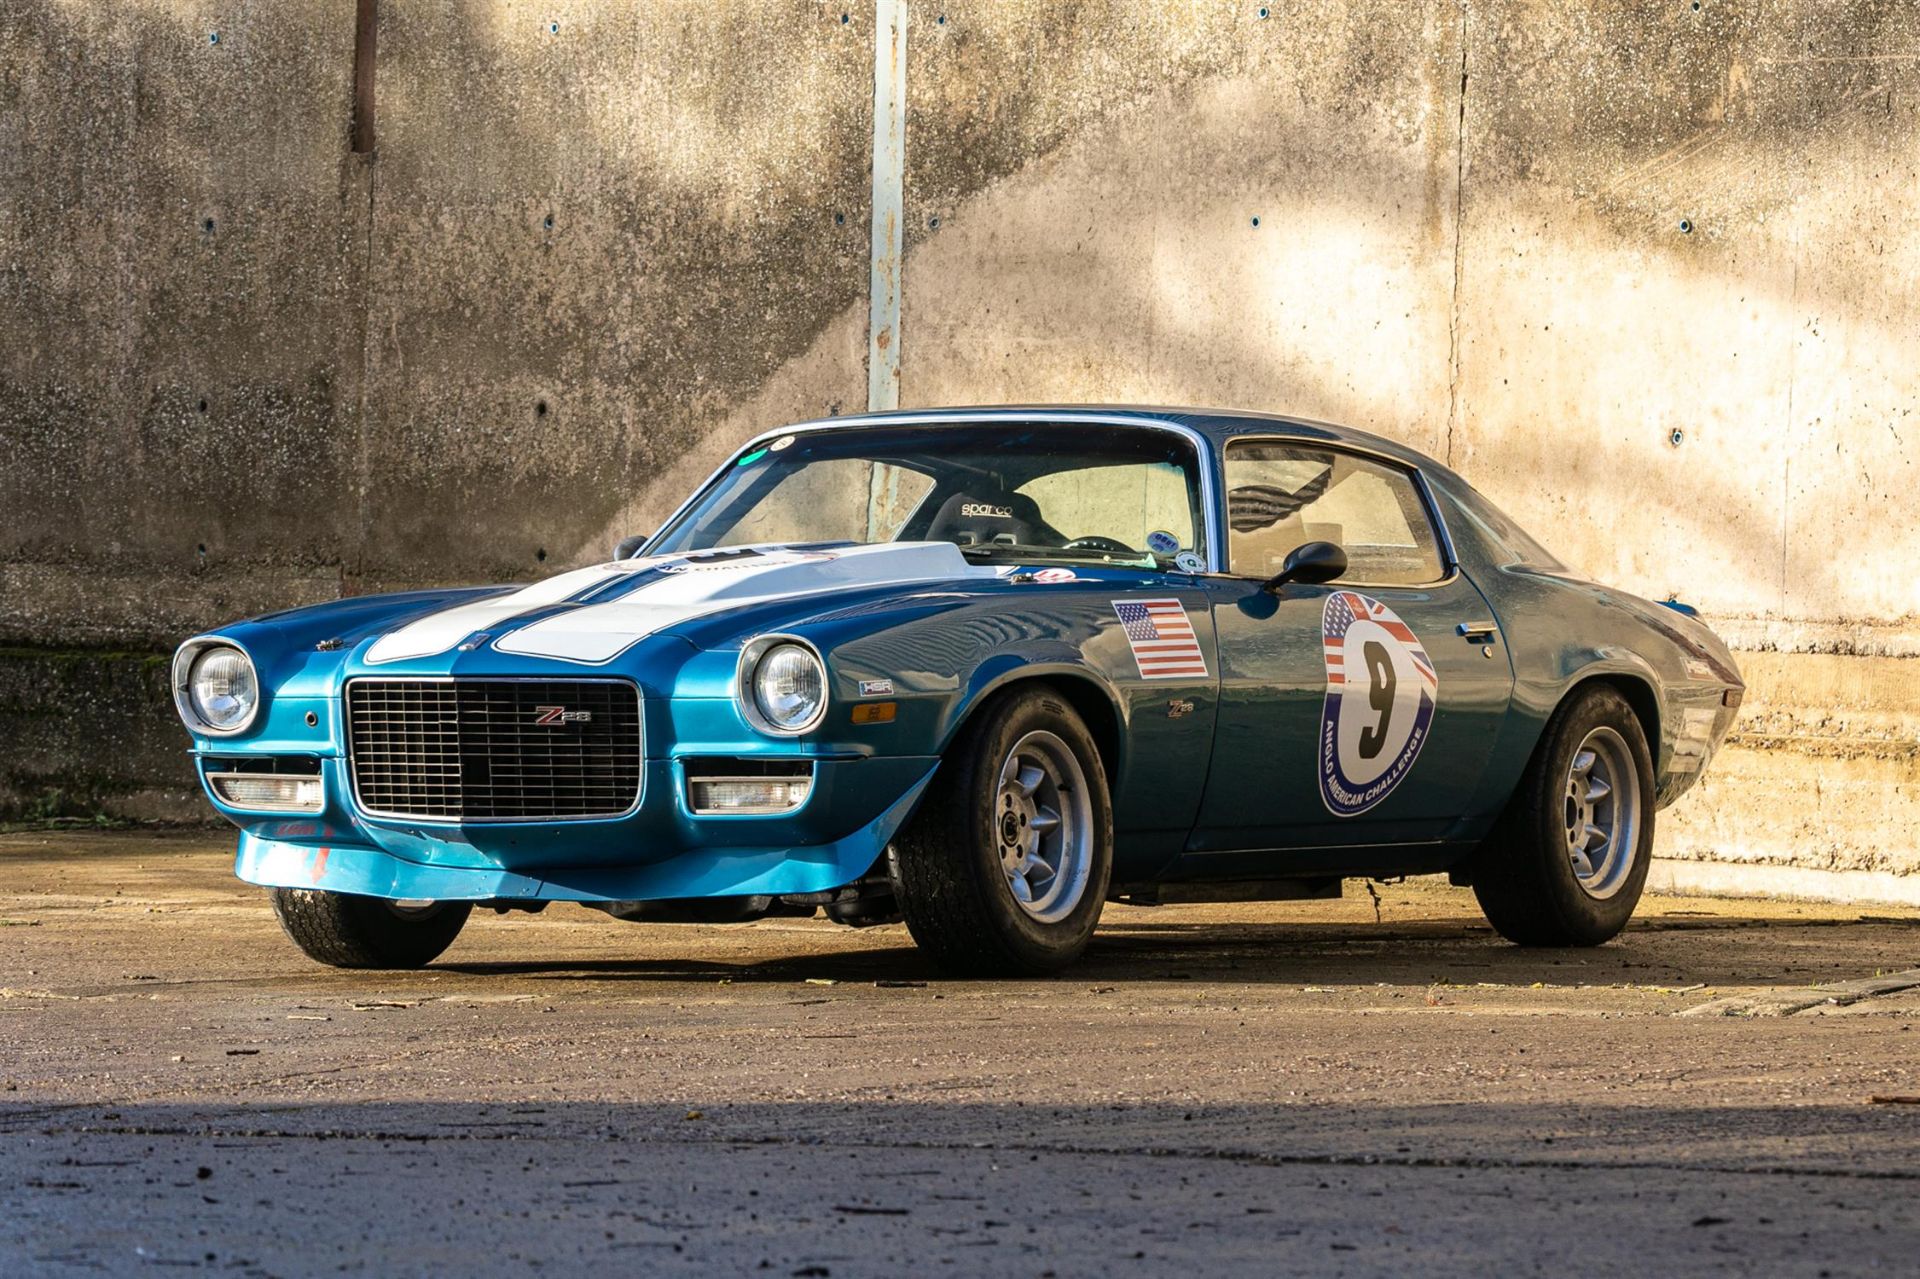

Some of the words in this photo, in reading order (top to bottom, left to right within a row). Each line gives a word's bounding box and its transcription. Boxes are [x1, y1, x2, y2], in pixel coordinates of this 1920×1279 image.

[961, 503, 1013, 518] sparco
[1358, 640, 1397, 759] 9
[1325, 719, 1335, 774] ANGLO
[1365, 727, 1423, 801] CHALLENGE
[1327, 774, 1365, 806] AMERICAN
